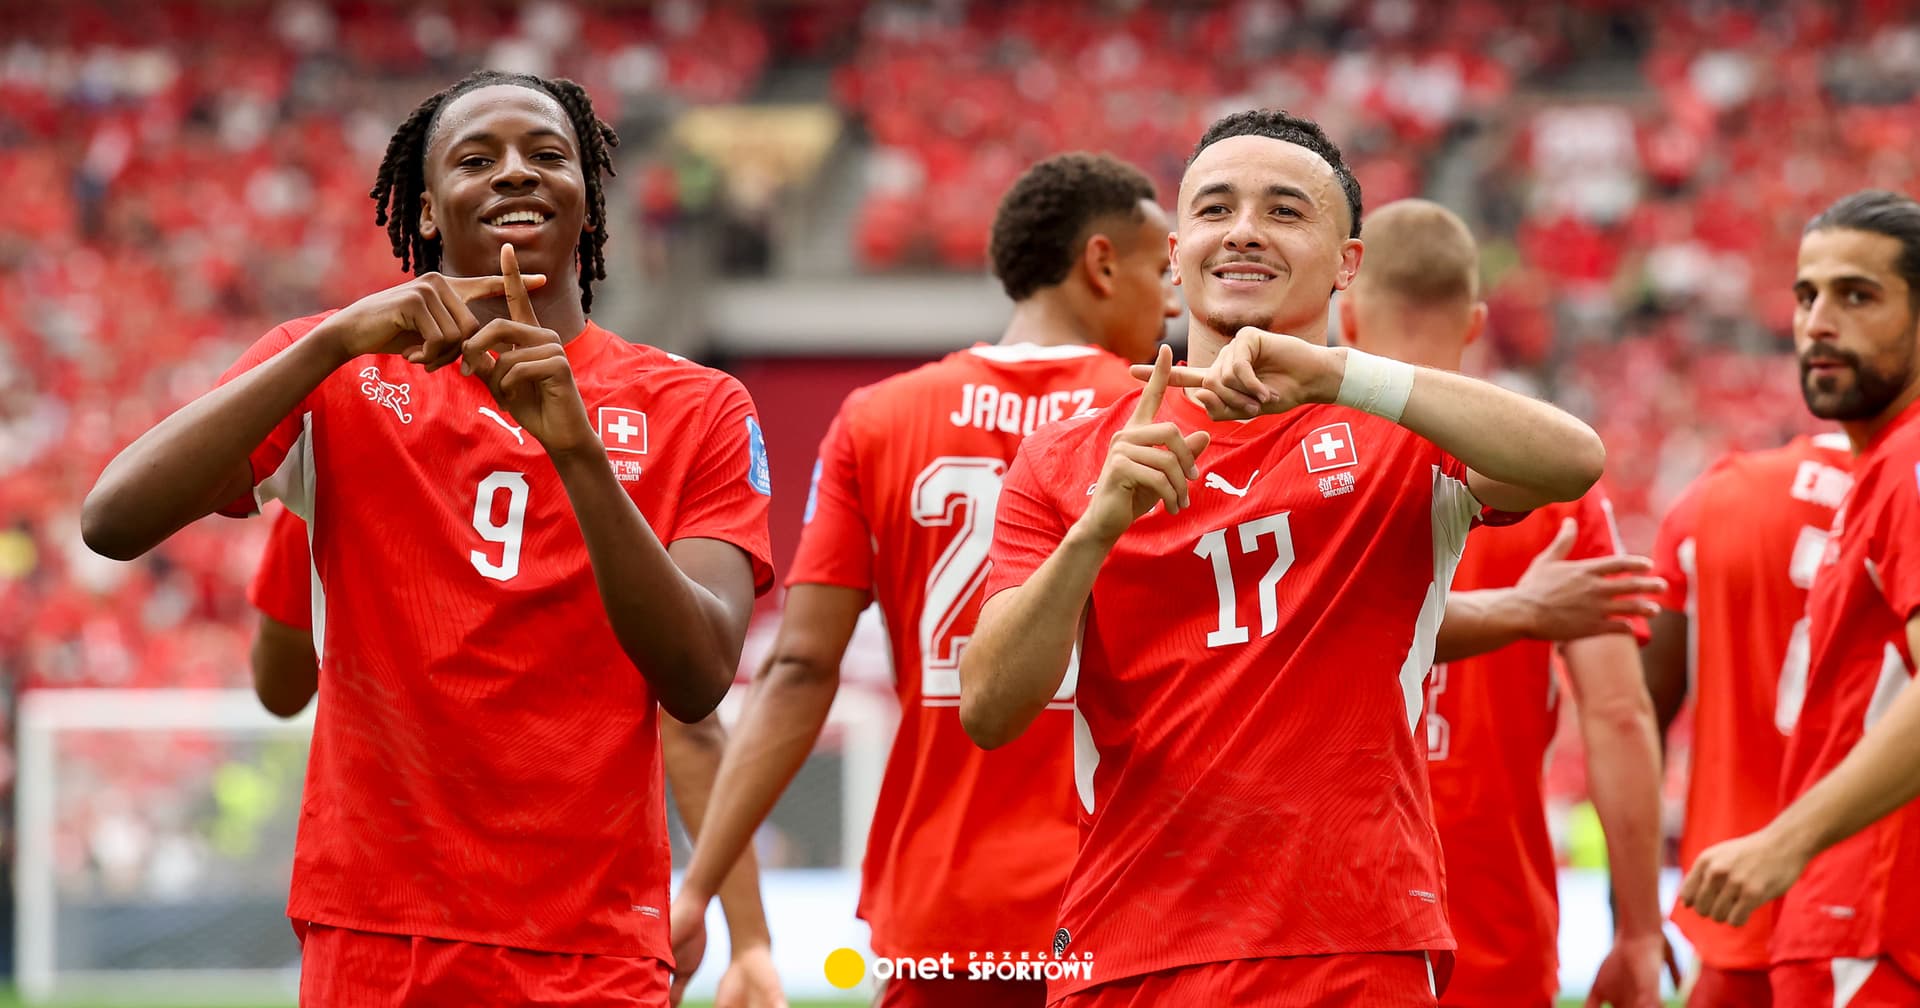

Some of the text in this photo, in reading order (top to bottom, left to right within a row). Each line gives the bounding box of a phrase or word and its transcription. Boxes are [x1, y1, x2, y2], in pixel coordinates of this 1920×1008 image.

[950, 383, 1095, 437] JAQUEZ
[470, 471, 529, 582] 9
[1193, 510, 1295, 648] 17
